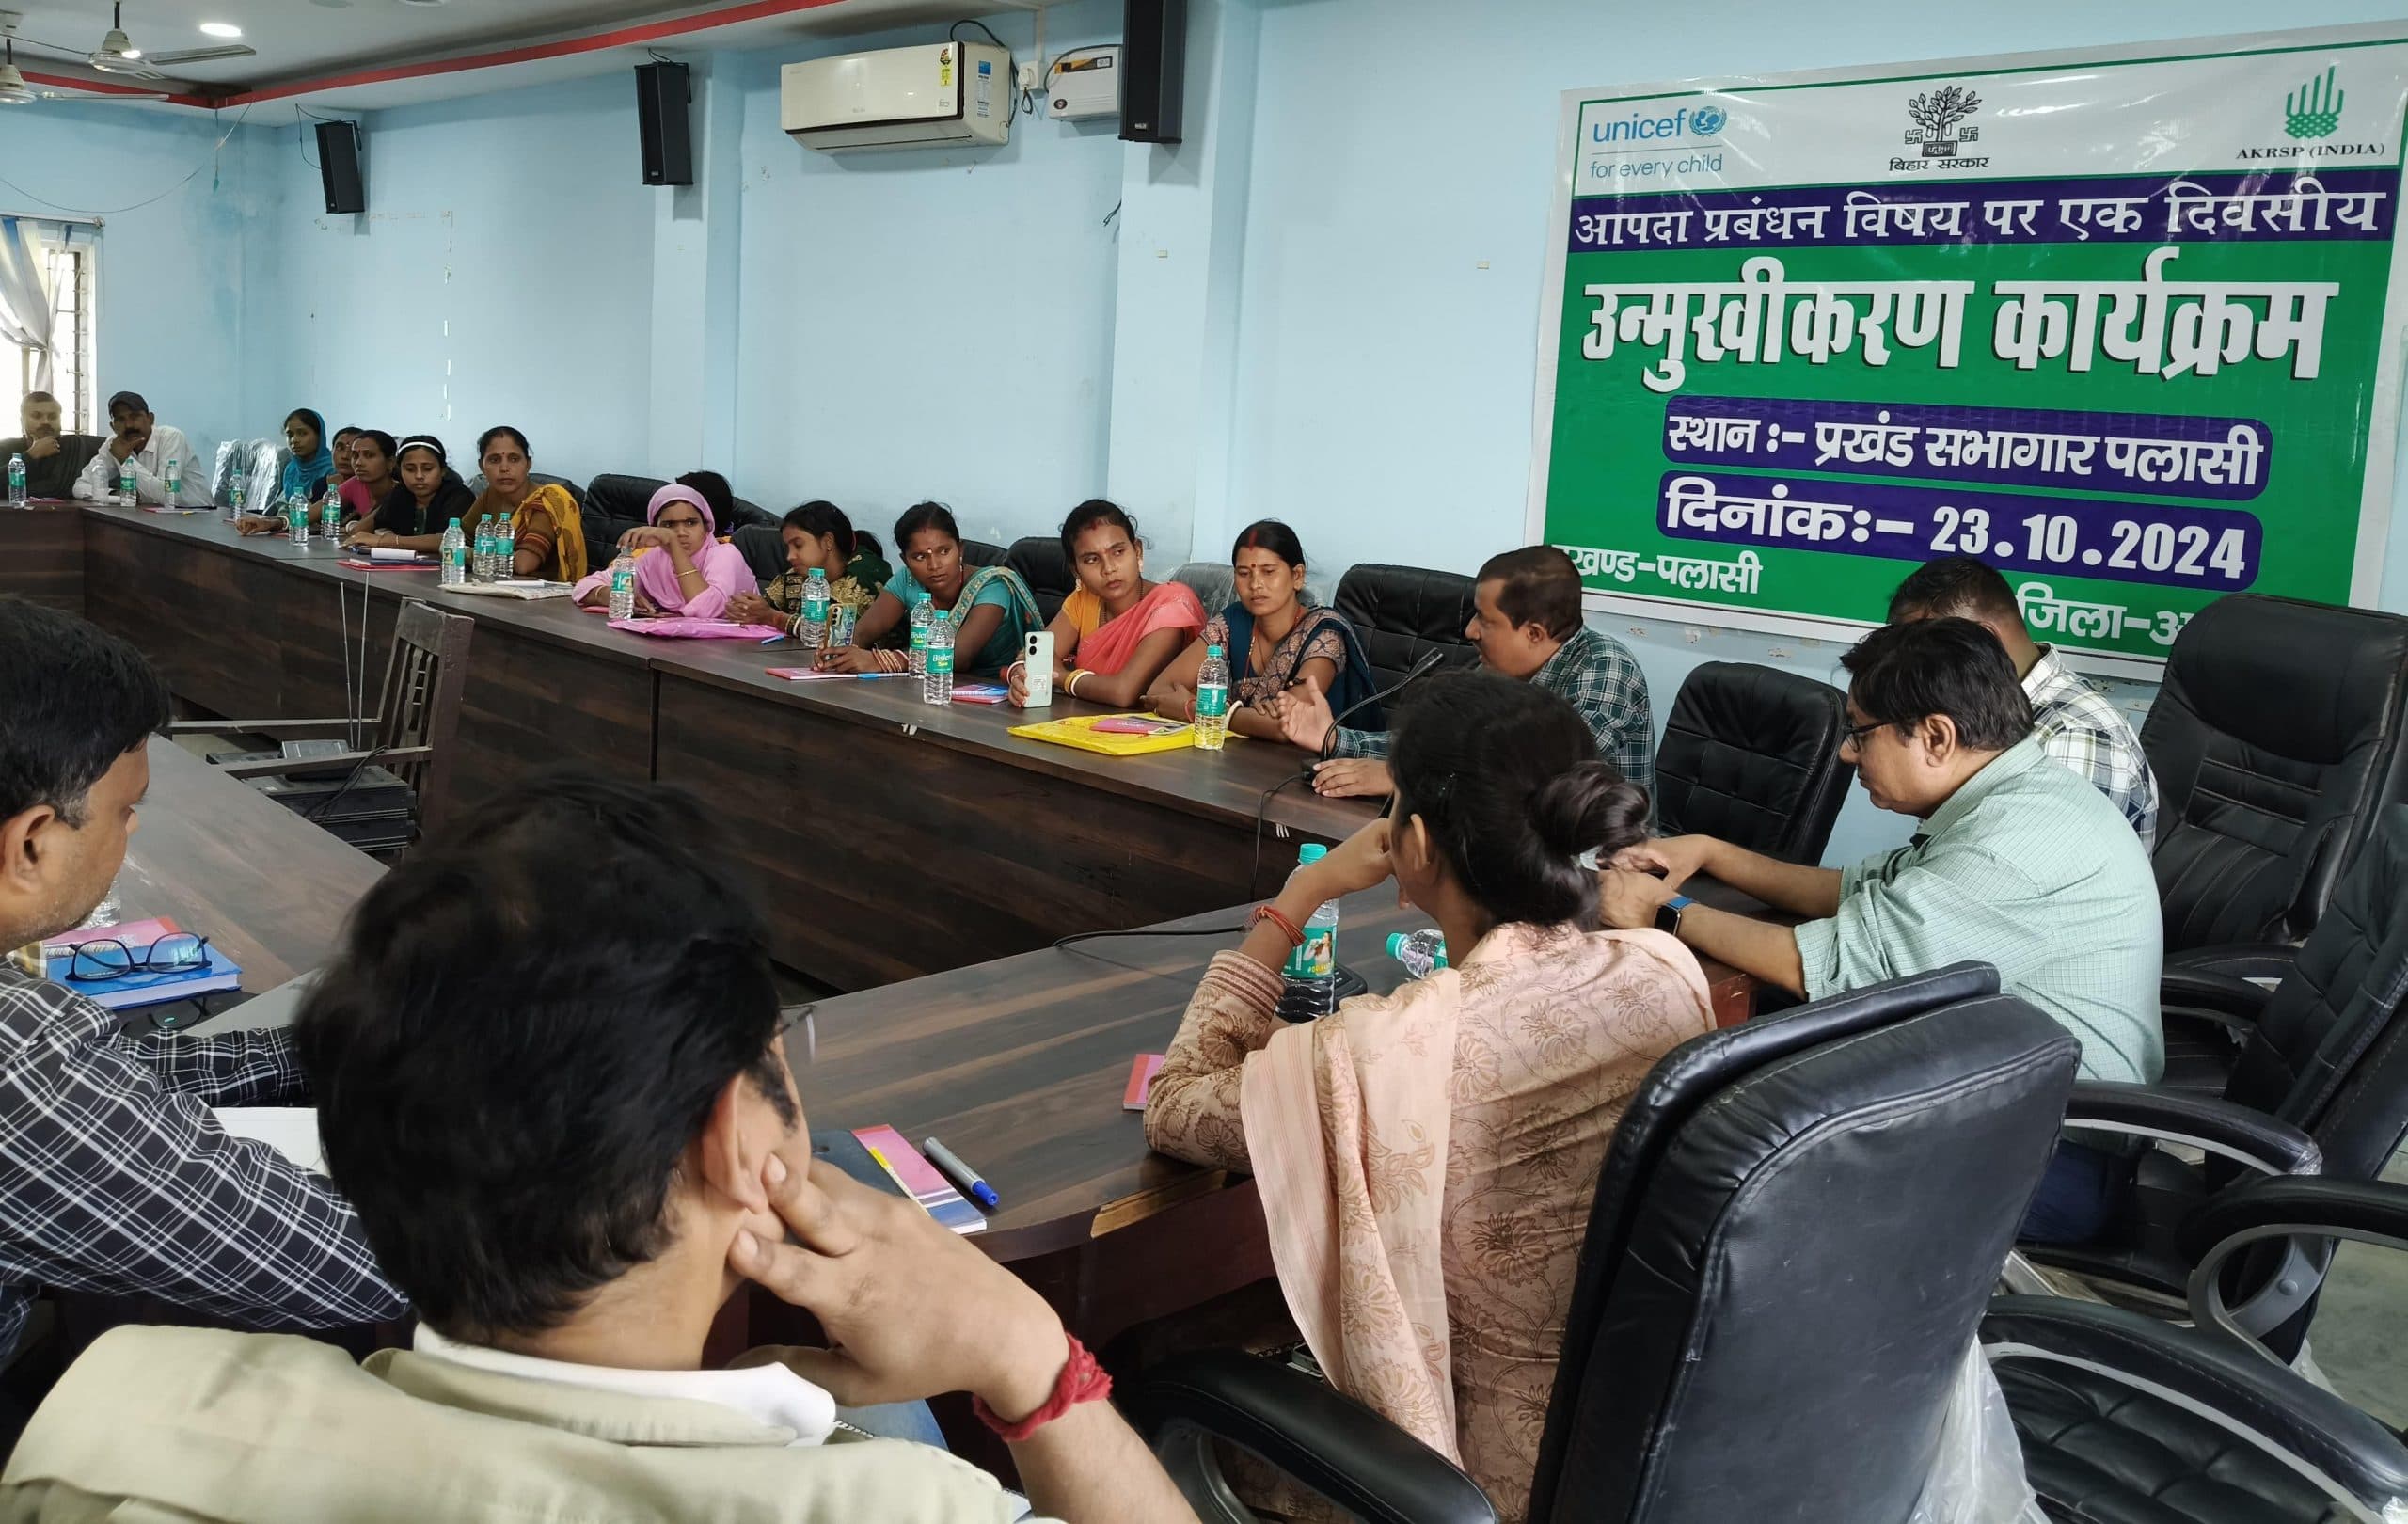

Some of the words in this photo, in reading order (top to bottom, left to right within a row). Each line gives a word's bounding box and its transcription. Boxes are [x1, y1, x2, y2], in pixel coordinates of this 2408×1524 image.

[1593, 108, 1687, 142] unicef
[1591, 161, 1615, 179] for
[1619, 161, 1673, 181] every
[1677, 153, 1723, 174] child
[1889, 157, 1930, 171] बिहार
[1937, 157, 1990, 169] सरकार
[2236, 147, 2305, 160] AKRSP
[2309, 143, 2384, 158] (INDIA)
[1575, 210, 1693, 245] आपदा
[1704, 196, 1830, 242] प्रबंधन
[1843, 190, 1970, 238] विषय
[1983, 199, 2044, 236] पर
[2058, 197, 2149, 241] एक
[2164, 177, 2387, 235] दिवसीय
[1992, 246, 2340, 381] कार्यक्रम
[1814, 410, 1920, 467] प्रखंड
[1925, 428, 2100, 475] सभागार
[2105, 424, 2264, 485] पलासी
[1930, 506, 2246, 579] 23.10.2024
[1551, 544, 1763, 595] खण्ड-पलासी
